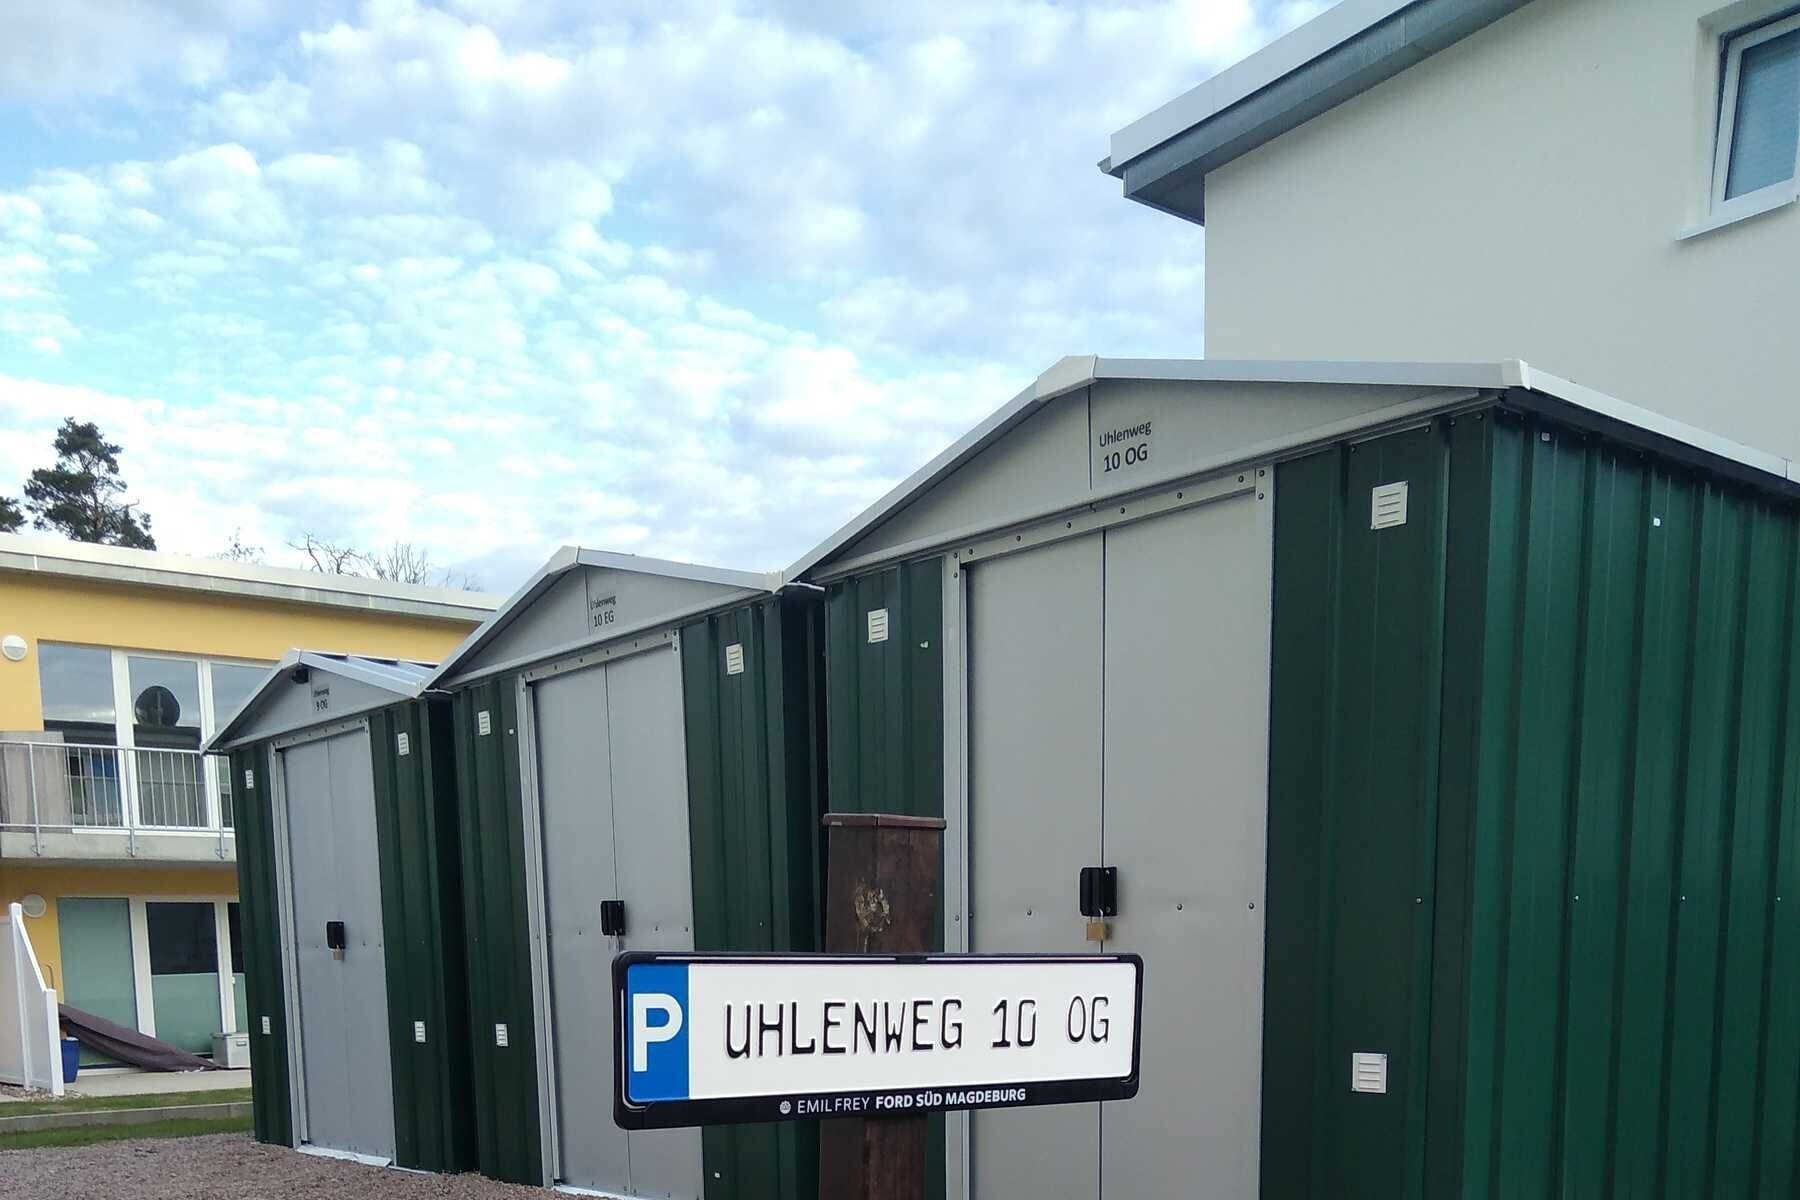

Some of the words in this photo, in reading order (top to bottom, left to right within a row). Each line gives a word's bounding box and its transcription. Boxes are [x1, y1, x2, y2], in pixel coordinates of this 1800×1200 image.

[1099, 421, 1152, 448] Uhlenweg
[1103, 451, 1121, 473] 10
[1125, 443, 1148, 466] OG
[593, 613, 603, 627] 10
[604, 610, 615, 624] EG
[632, 993, 683, 1073] P
[723, 998, 963, 1060] UHLENWEG
[991, 998, 1037, 1049] 10
[1067, 995, 1110, 1045] OG
[797, 1098, 833, 1114] EMIL
[834, 1096, 870, 1112] FREY
[875, 1094, 913, 1110] FORD
[915, 1090, 943, 1107] SÜD
[945, 1088, 1026, 1105] MAGDEBURG
